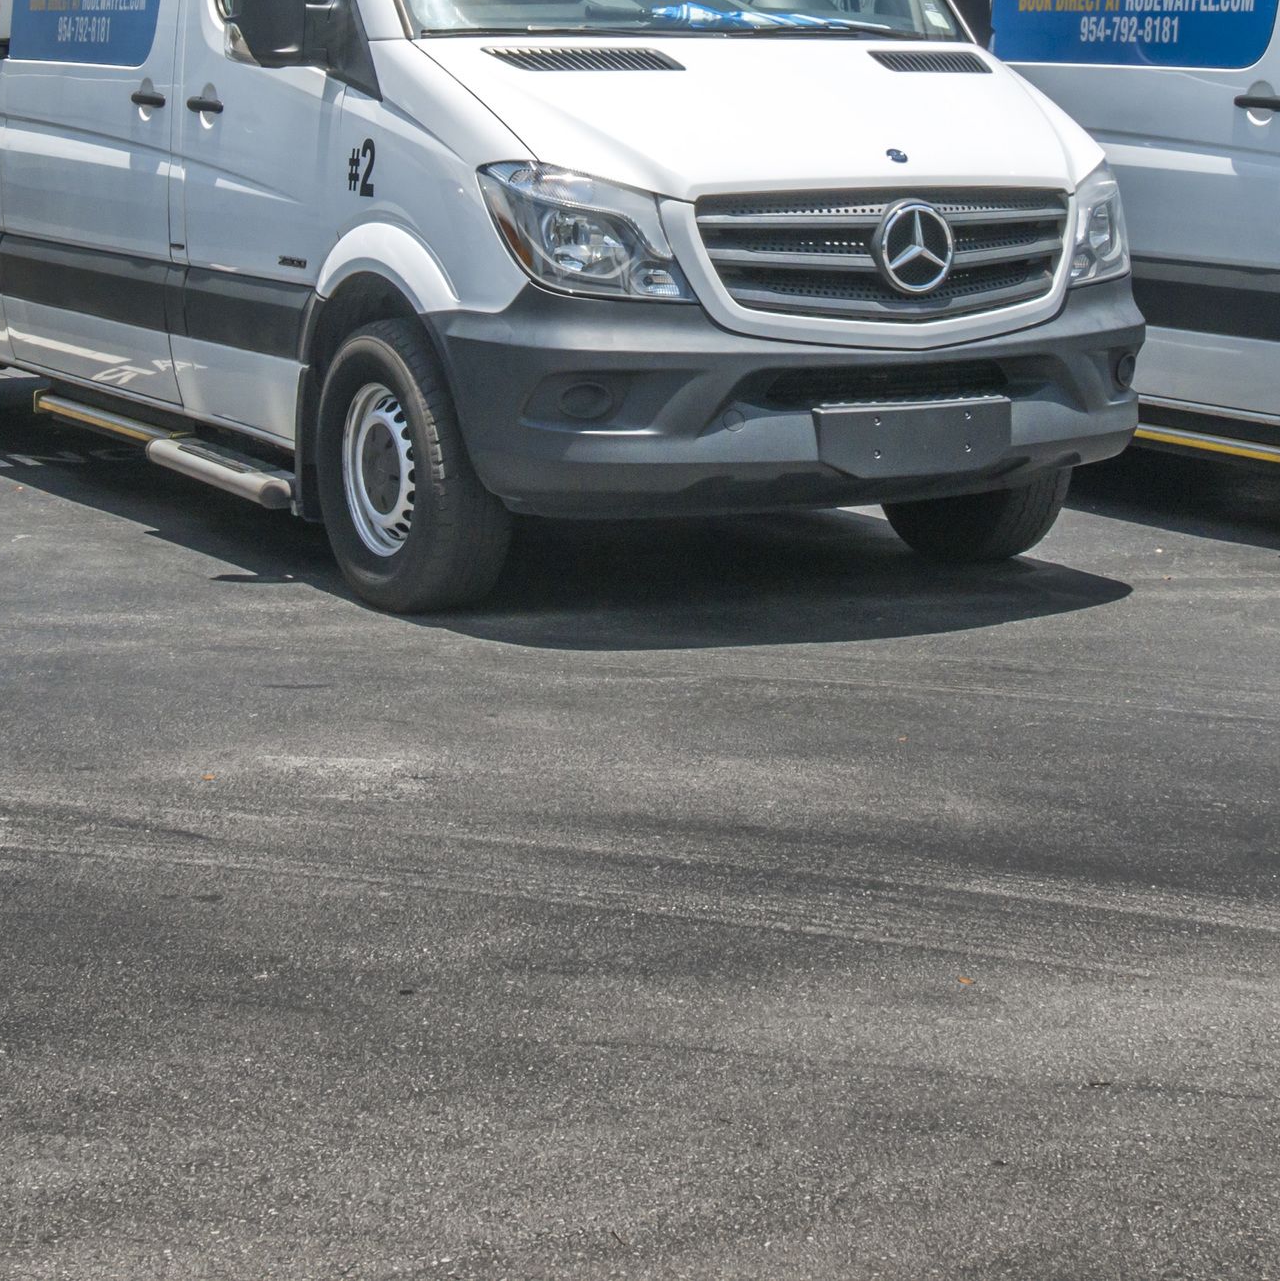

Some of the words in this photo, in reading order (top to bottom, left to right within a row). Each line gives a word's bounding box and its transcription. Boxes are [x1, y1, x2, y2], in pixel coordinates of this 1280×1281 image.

[58, 16, 110, 42] 954-792-8181
[1080, 16, 1180, 43] 954-792-8181
[349, 138, 376, 197] #2
